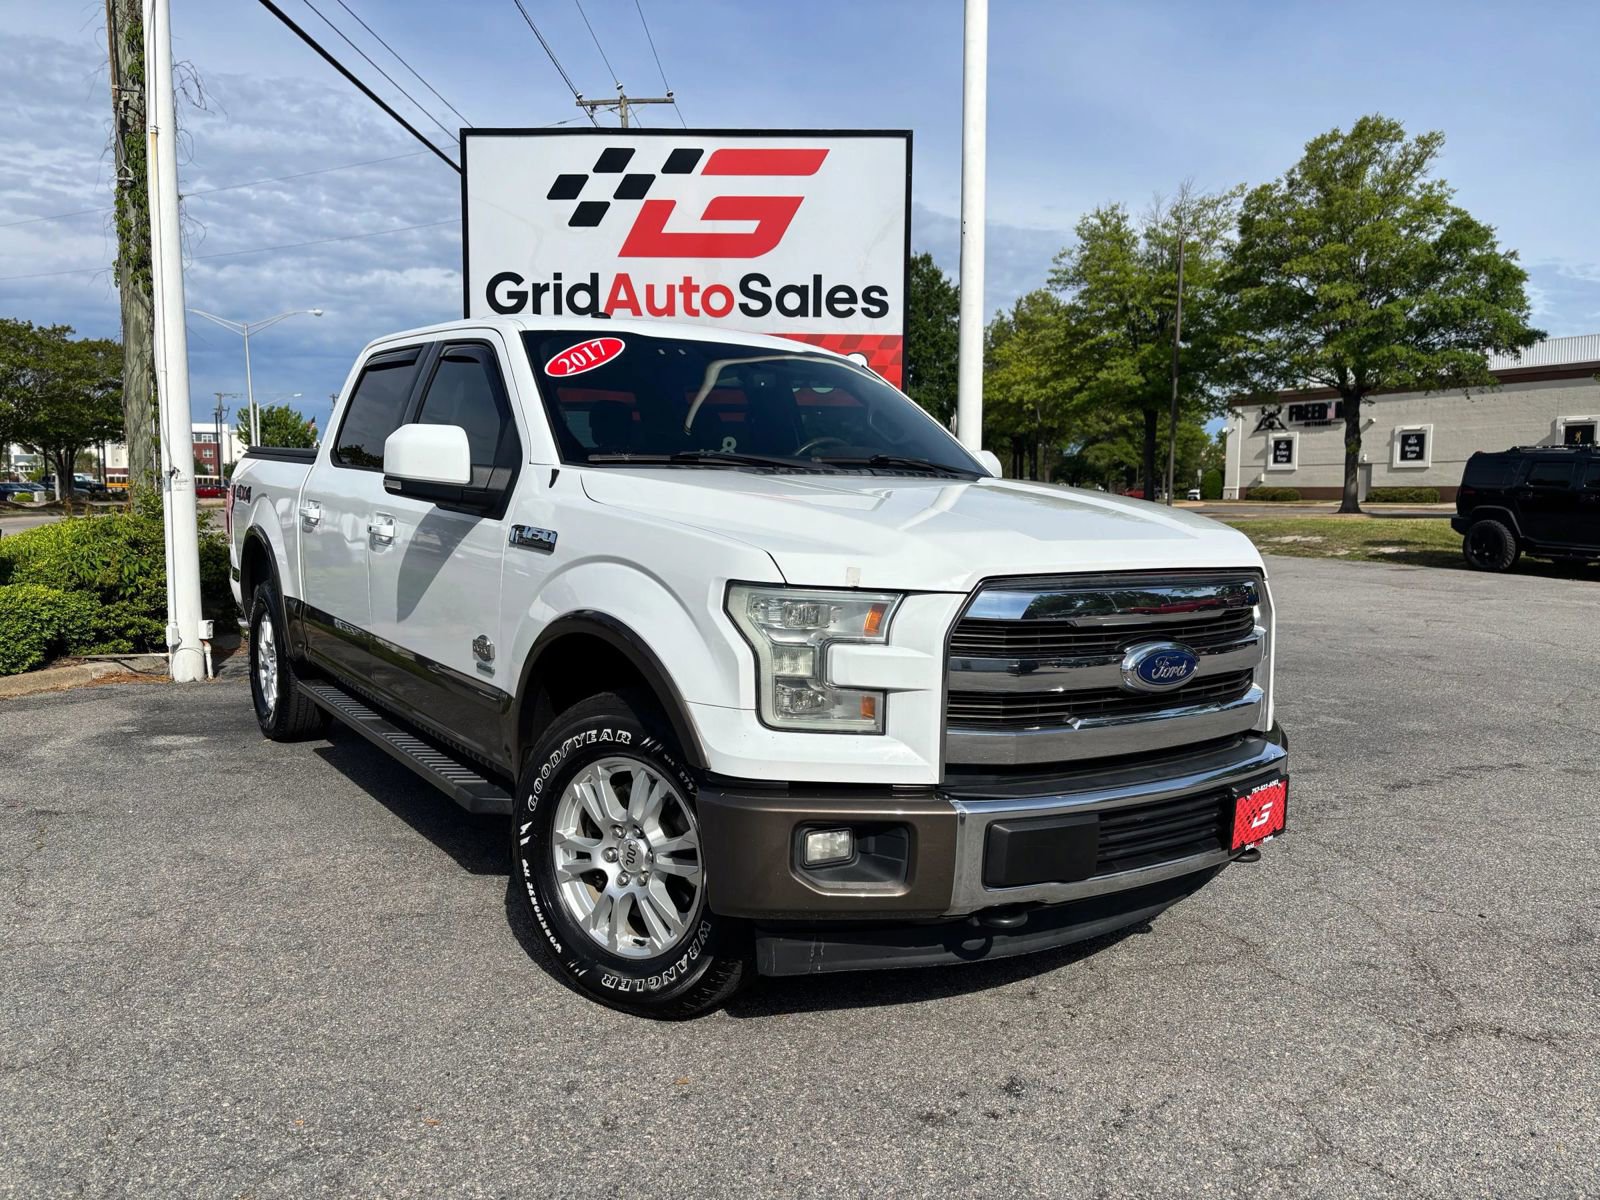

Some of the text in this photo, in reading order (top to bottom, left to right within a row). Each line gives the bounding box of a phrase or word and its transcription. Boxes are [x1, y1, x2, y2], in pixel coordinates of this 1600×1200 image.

[557, 340, 607, 375] 2017
[1151, 655, 1187, 680] Ford
[527, 728, 633, 812] GOODYEAR
[526, 881, 562, 955] WORKHORSE
[601, 919, 712, 993] WRANGLER
